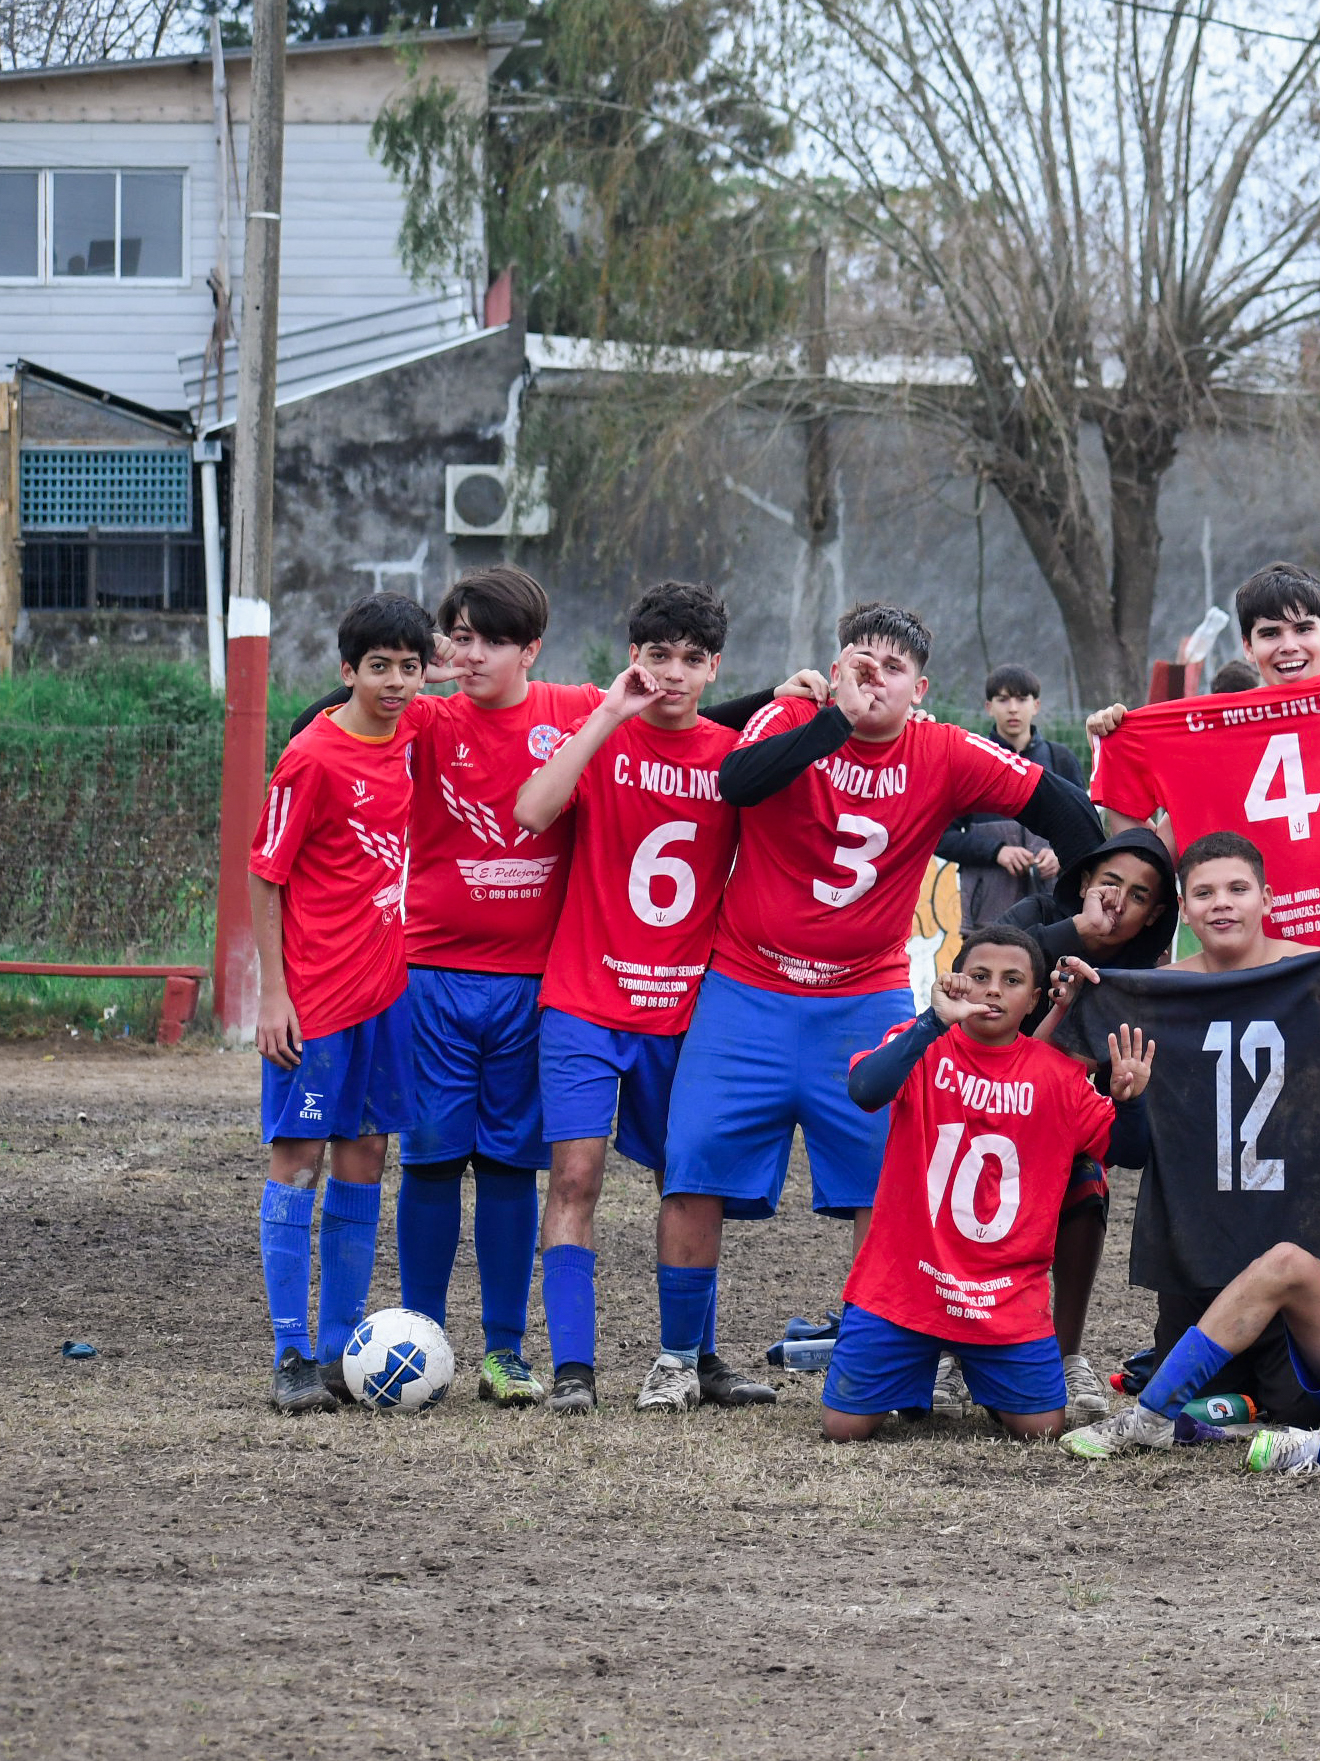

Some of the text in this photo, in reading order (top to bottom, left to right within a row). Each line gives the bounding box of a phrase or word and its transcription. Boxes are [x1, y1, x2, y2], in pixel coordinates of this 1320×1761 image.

[614, 753, 634, 787] C.
[812, 813, 889, 908] 3
[479, 867, 540, 879] E. Pellejero
[628, 820, 698, 928] 6
[489, 887, 542, 900] 099 06 09 07
[1294, 888, 1320, 904] MOVING
[1281, 926, 1295, 938] 099
[1295, 924, 1304, 936] 06
[1304, 921, 1314, 934] 09
[618, 977, 688, 993] SYBMUDANZAS.COM
[630, 994, 679, 1008] 099 06 09 07
[934, 1056, 1035, 1116] C. MOLINO
[1202, 1020, 1285, 1191] 12
[299, 1110, 323, 1121] ELITE
[926, 1122, 1020, 1243] 10
[980, 1276, 1014, 1293] SERVICE
[946, 1304, 963, 1318] 099
